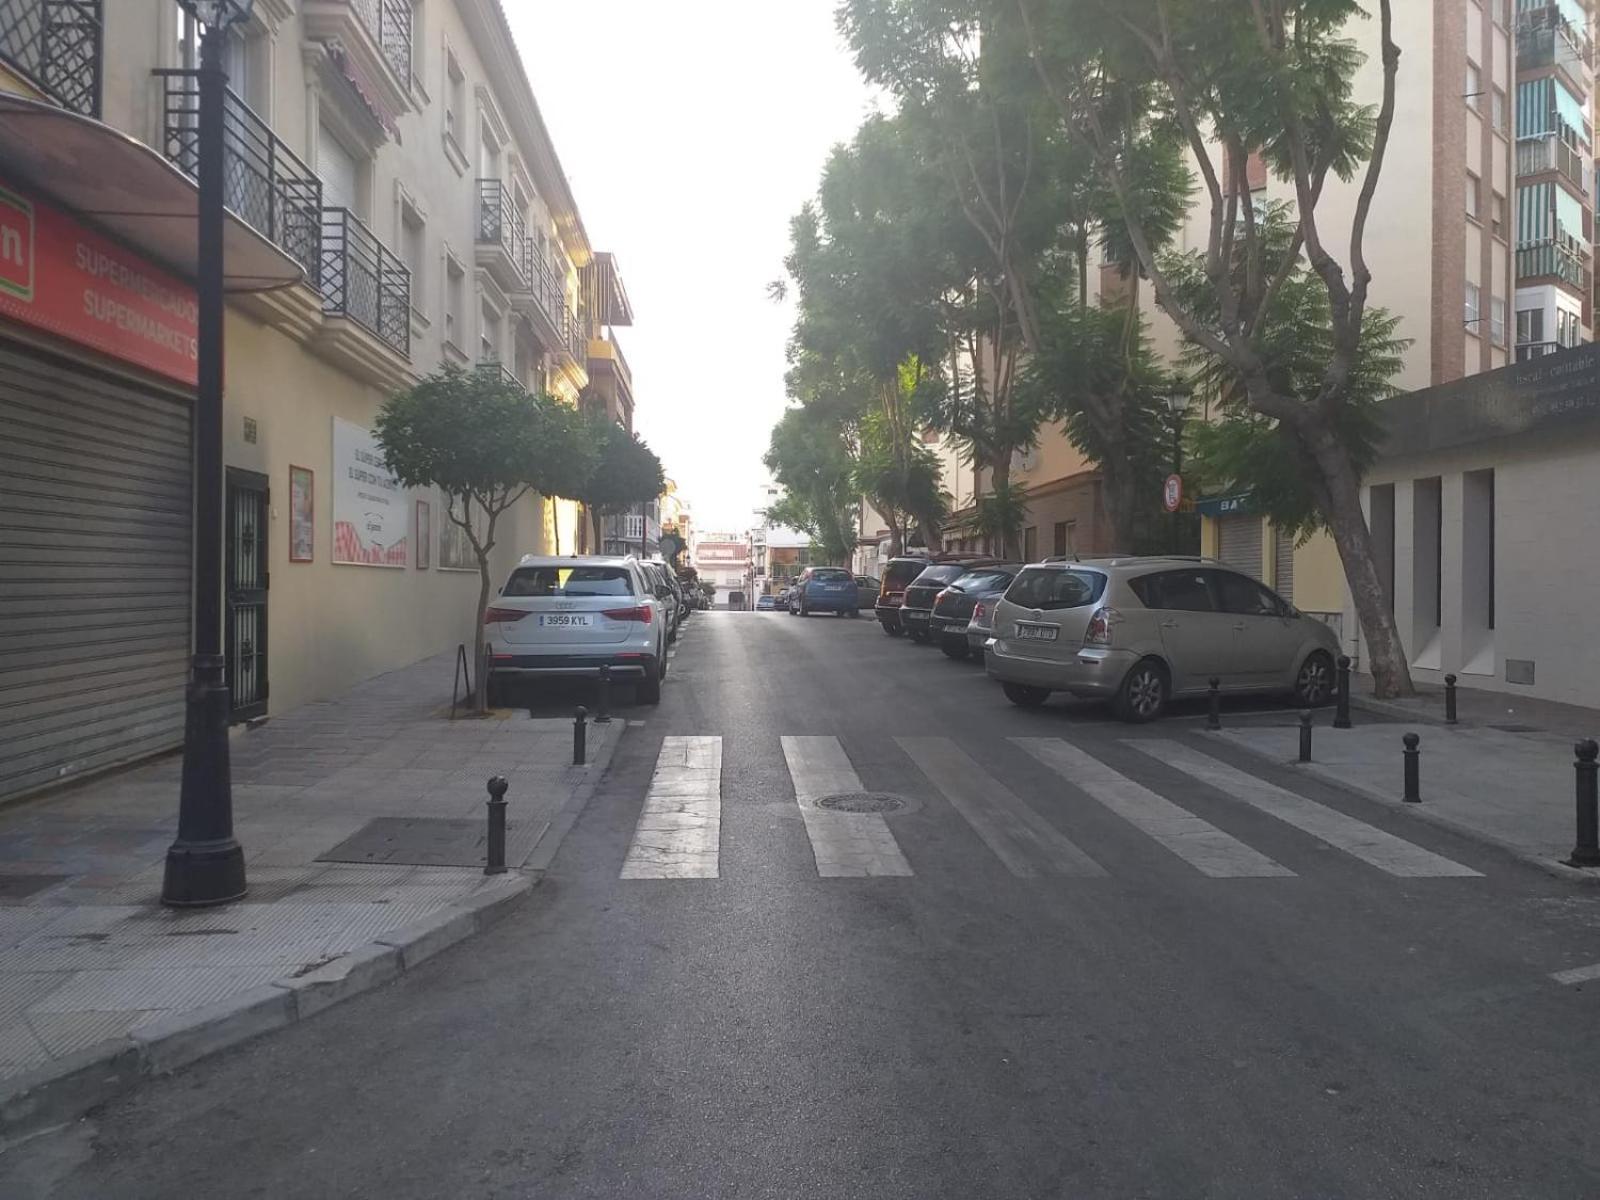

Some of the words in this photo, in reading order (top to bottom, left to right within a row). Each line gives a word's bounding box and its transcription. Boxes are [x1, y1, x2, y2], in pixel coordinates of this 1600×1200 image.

[83, 288, 199, 361] SUPERMARKETS
[546, 615, 571, 626] 3959
[571, 615, 589, 627] KYL
